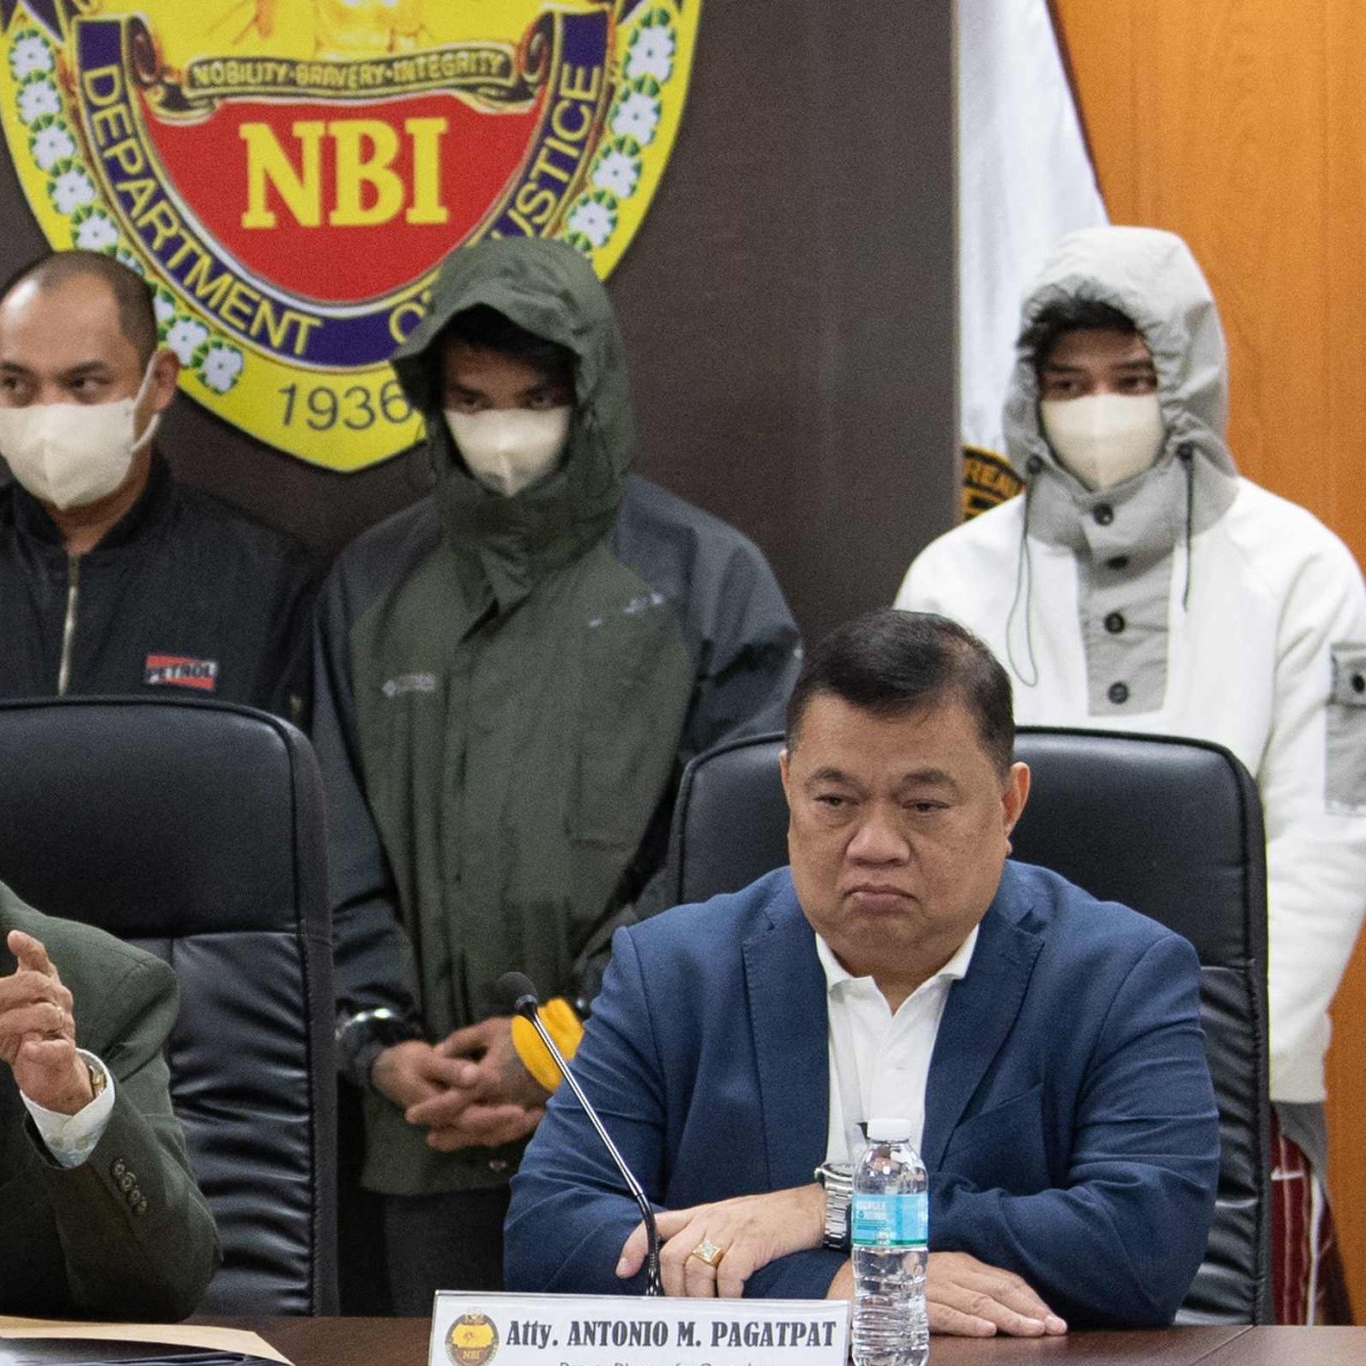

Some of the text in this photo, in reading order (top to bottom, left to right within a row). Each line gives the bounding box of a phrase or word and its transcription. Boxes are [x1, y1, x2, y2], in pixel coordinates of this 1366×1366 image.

[83, 64, 323, 356] DEPARTMENT
[238, 117, 449, 230] NBI
[279, 378, 413, 432] 1936
[506, 1320, 836, 1349] Atty. ANTONIO M. PAGATPAT
